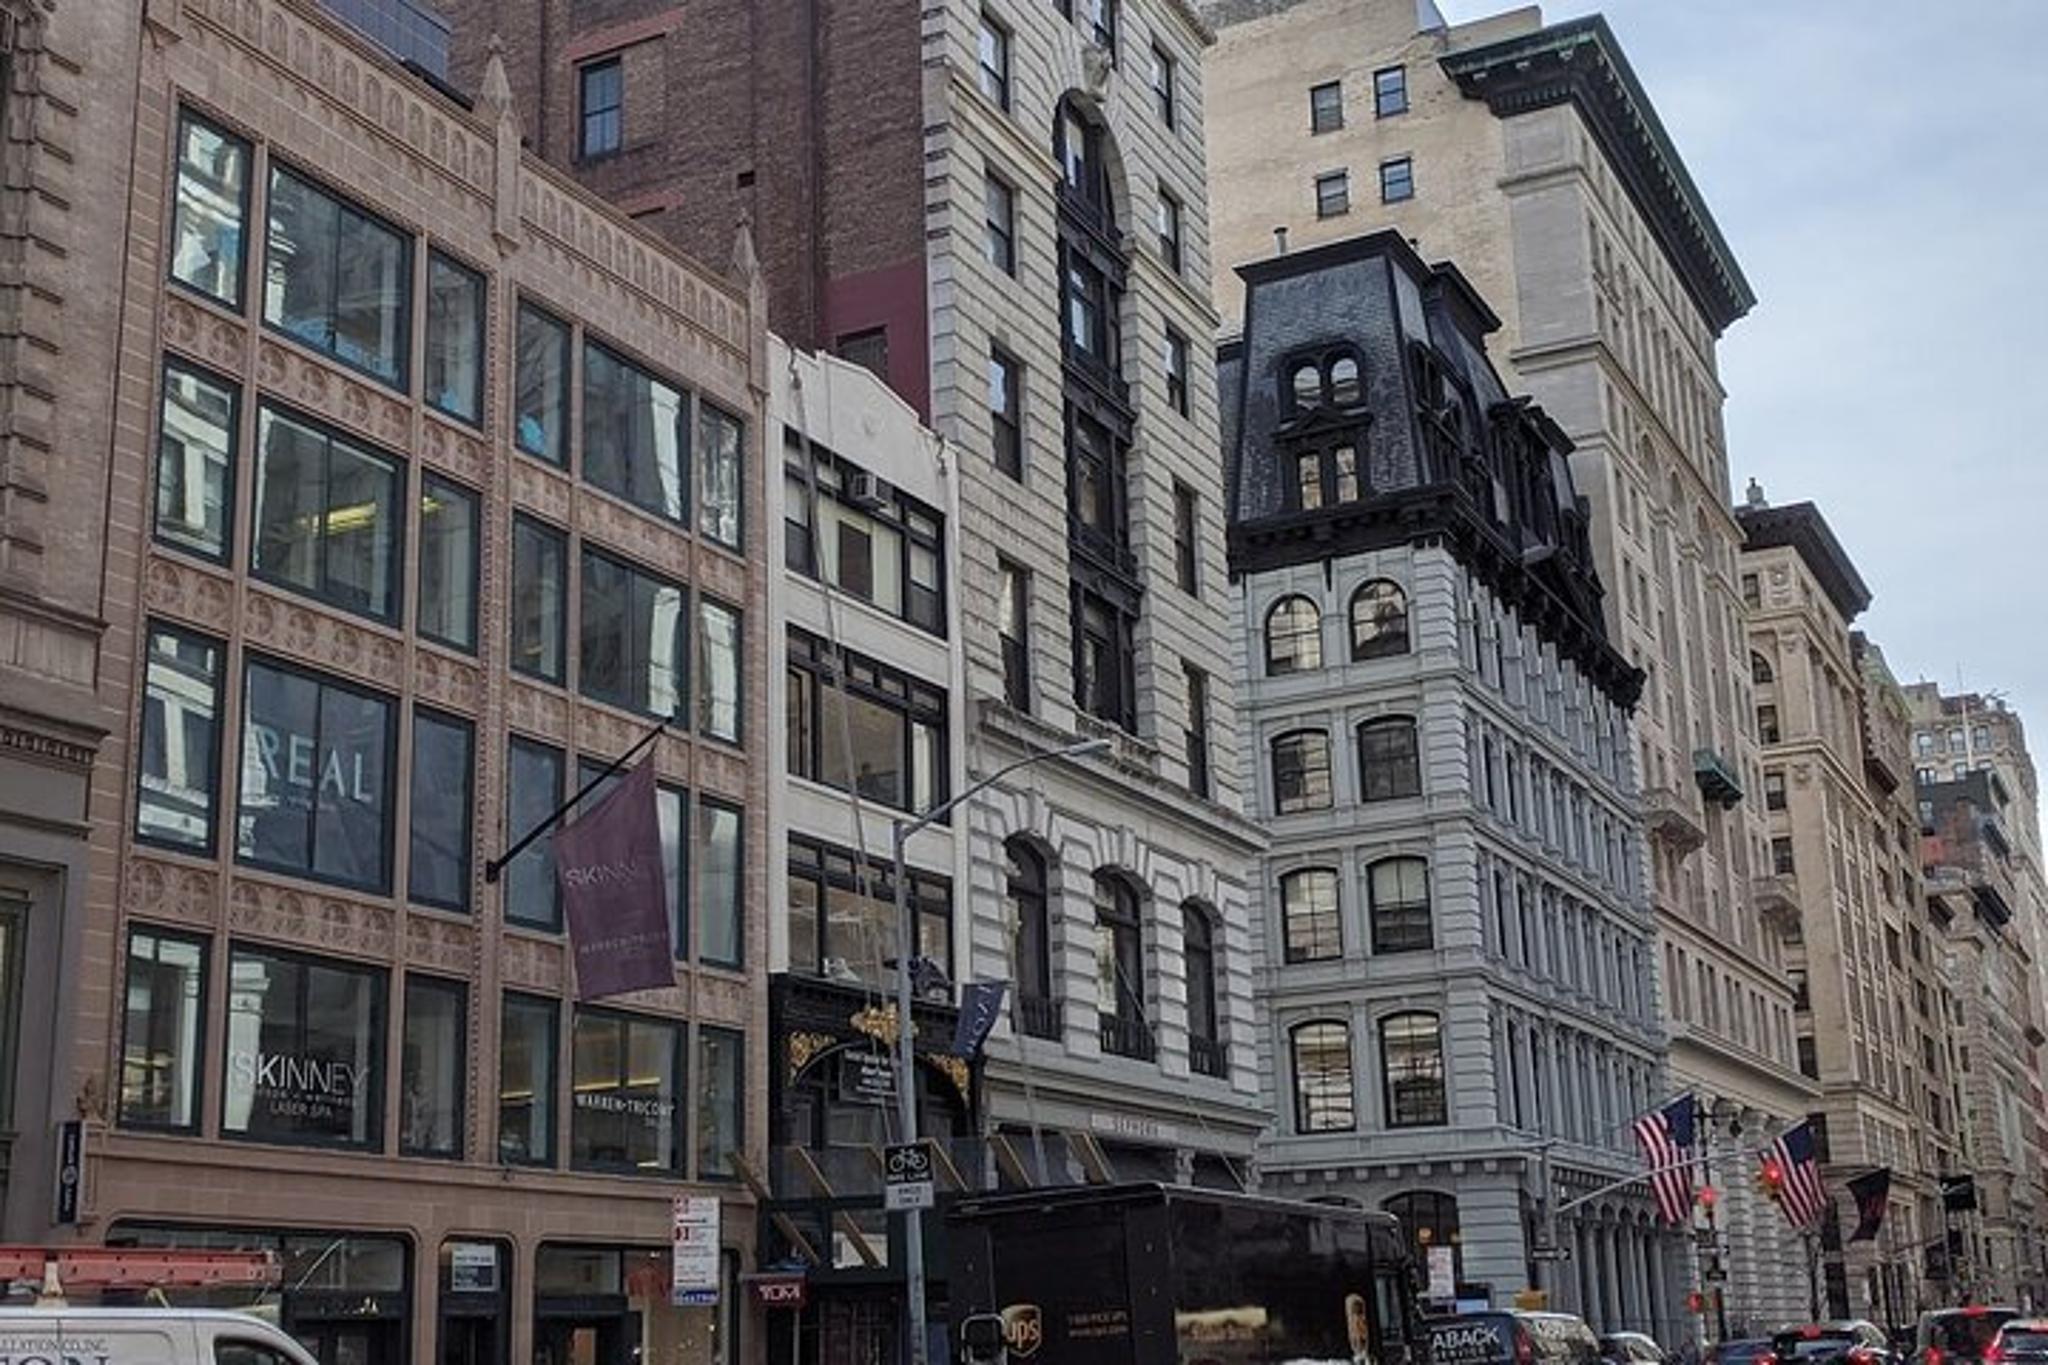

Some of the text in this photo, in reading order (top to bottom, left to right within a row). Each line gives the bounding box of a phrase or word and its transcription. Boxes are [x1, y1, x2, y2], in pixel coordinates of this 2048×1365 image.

[254, 724, 373, 803] REAL
[233, 1051, 369, 1095] SKINNEY
[269, 1101, 333, 1118] LASER SPA
